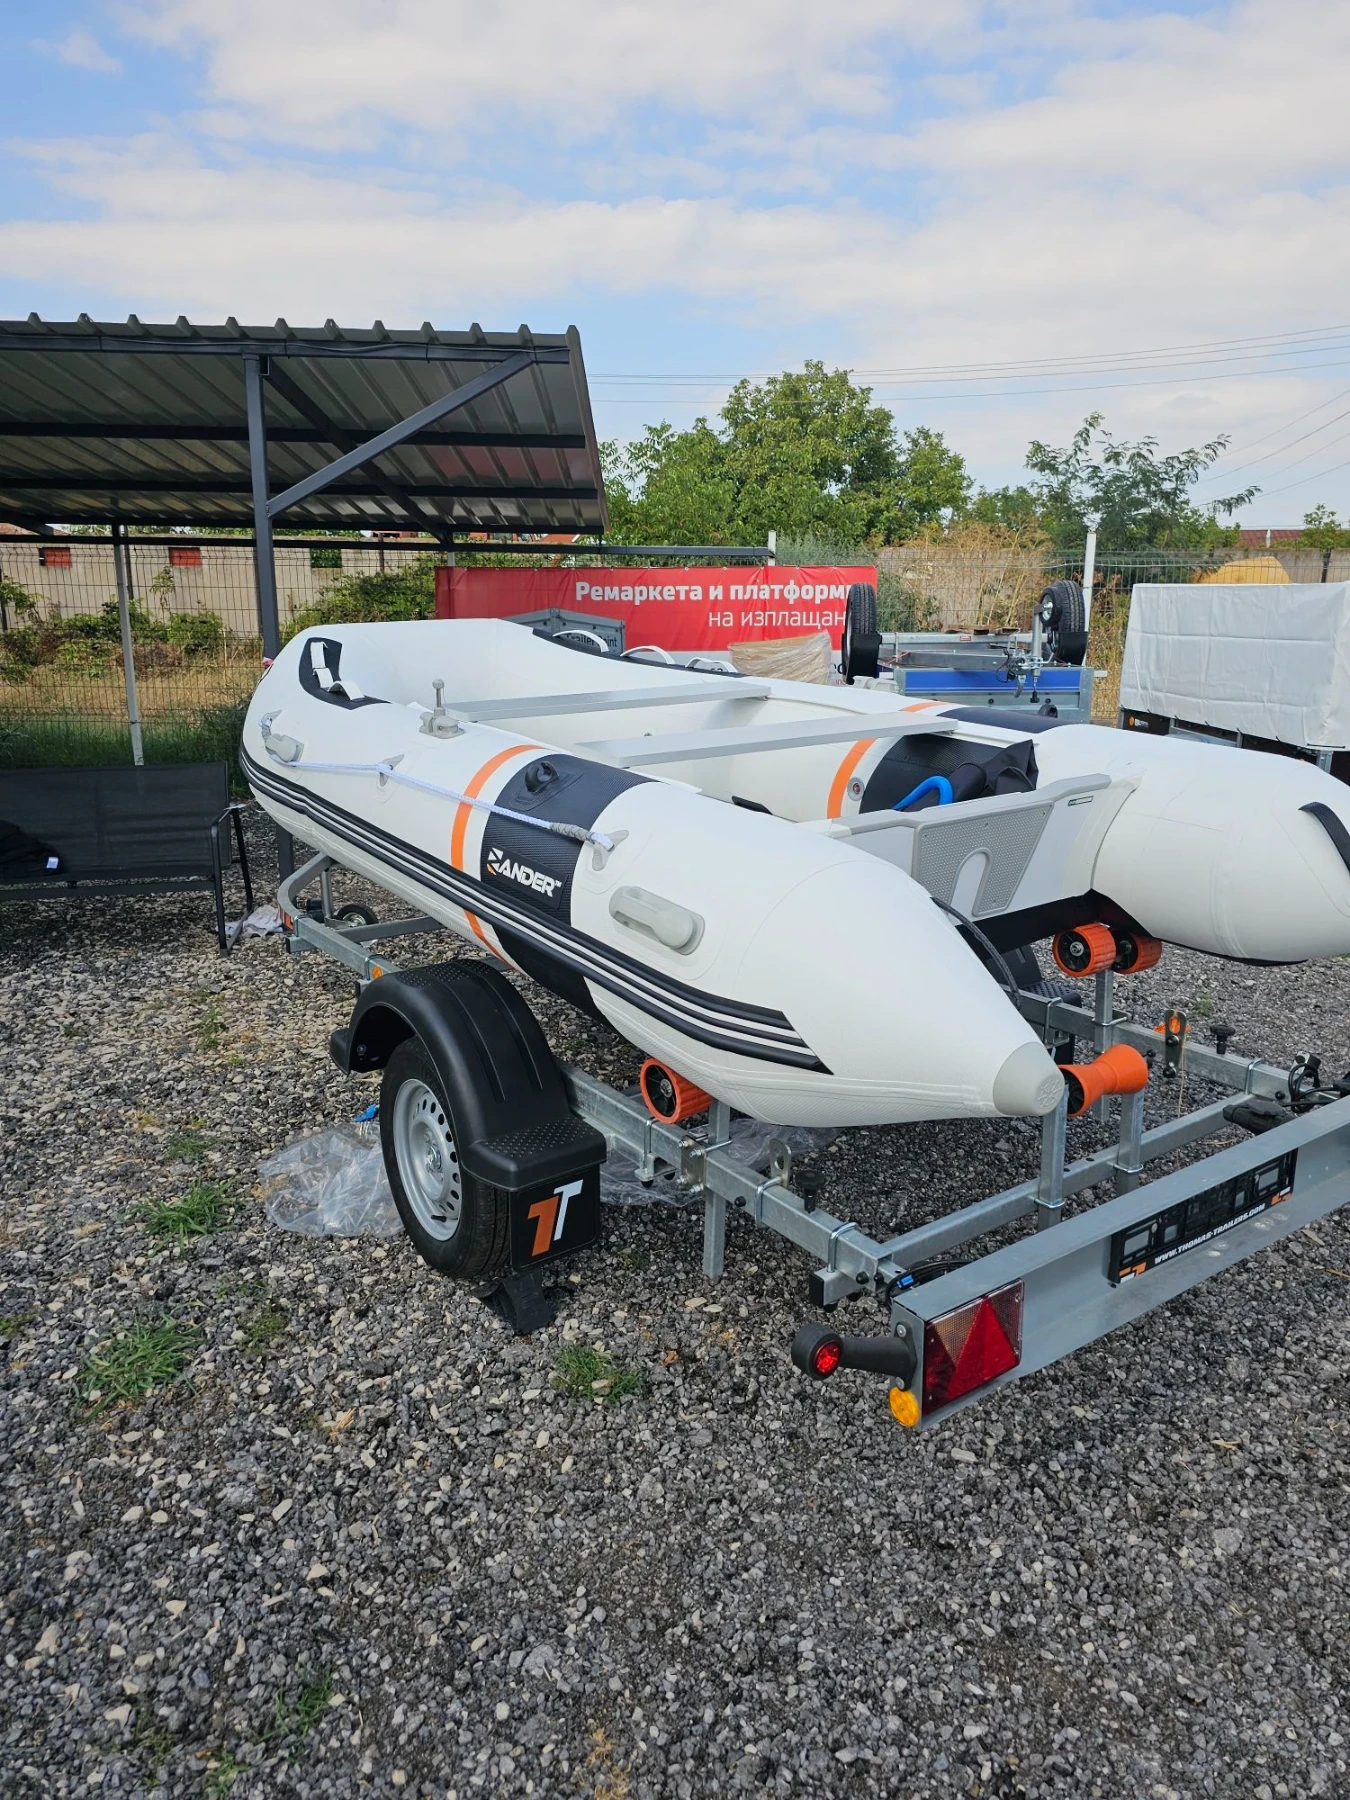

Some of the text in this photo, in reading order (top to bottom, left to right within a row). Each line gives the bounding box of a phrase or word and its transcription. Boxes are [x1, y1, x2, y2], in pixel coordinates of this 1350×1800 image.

[575, 581, 703, 606] Ремаркета
[709, 585, 723, 600] и
[709, 611, 846, 629] на изплащан
